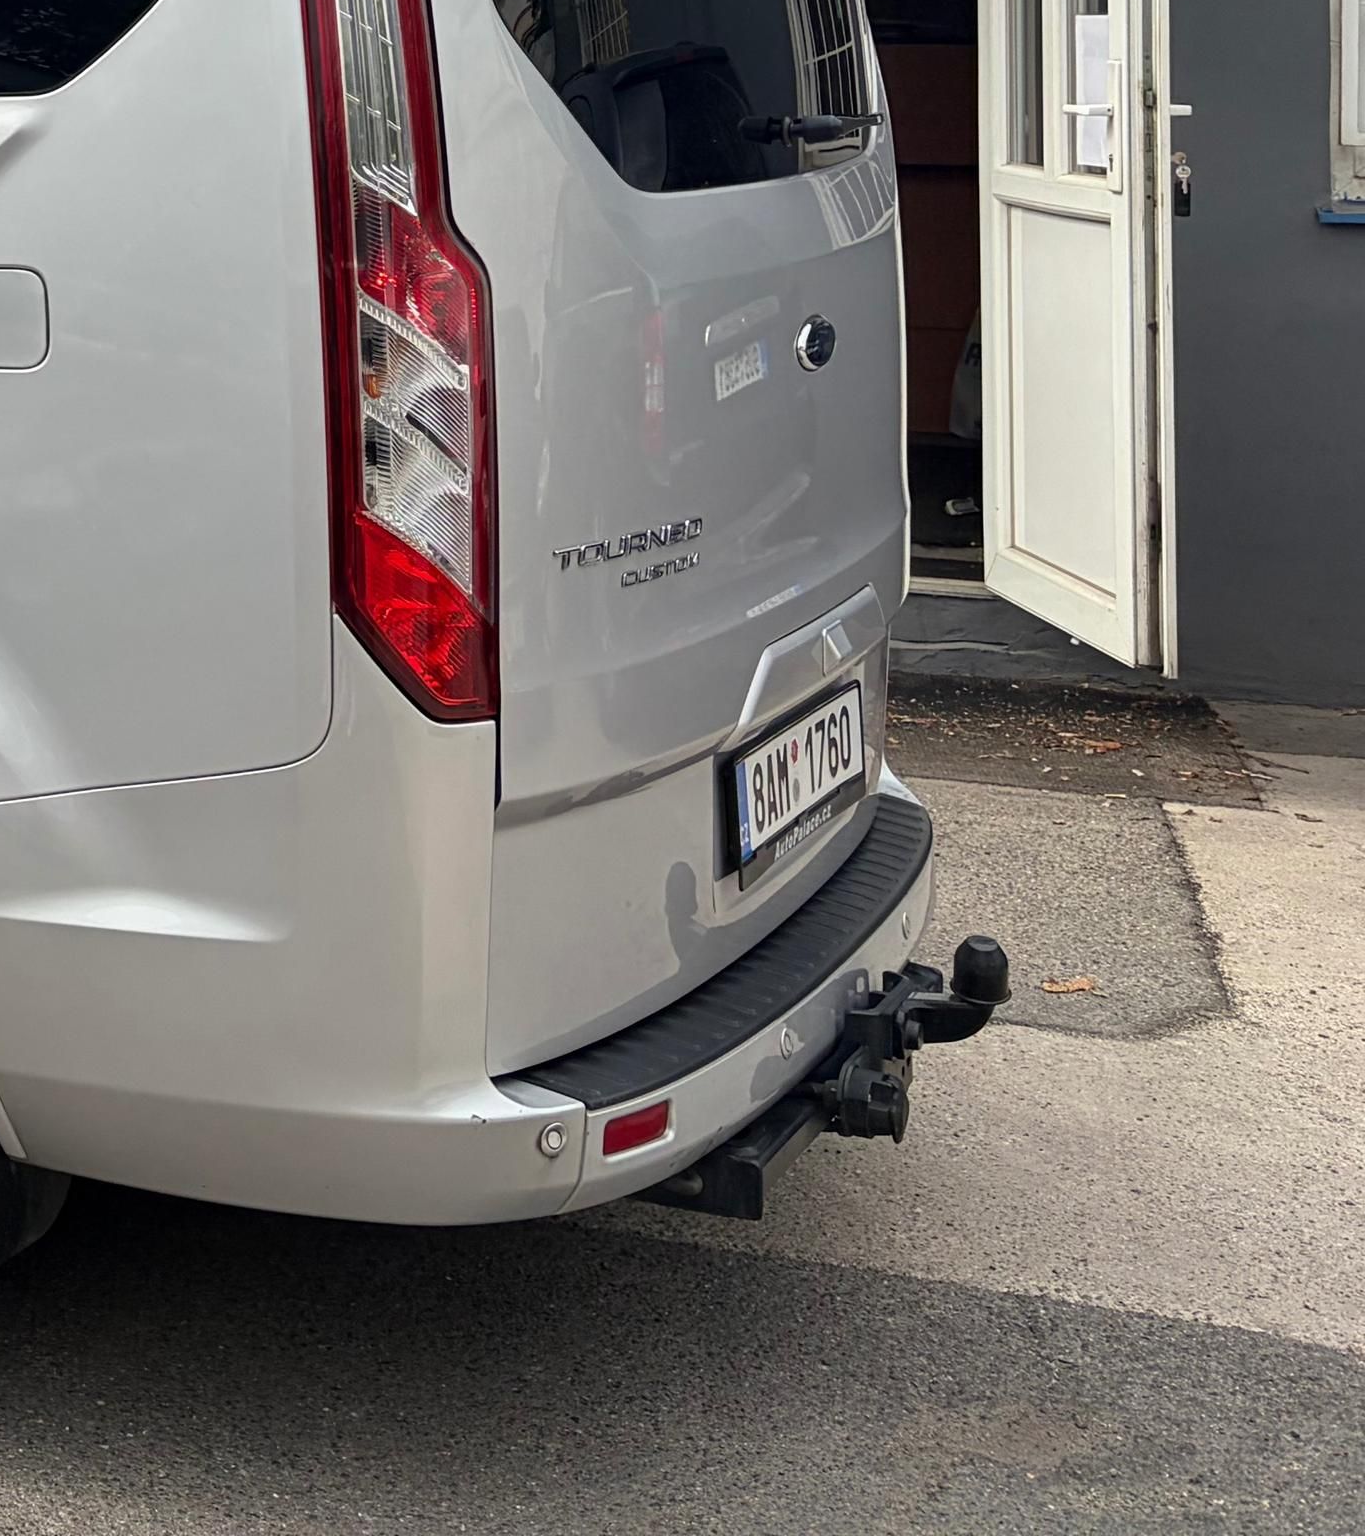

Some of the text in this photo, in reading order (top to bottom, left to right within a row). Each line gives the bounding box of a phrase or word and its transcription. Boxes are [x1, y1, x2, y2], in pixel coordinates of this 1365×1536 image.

[552, 517, 703, 571] TOURNEO
[752, 704, 852, 835] 8AM 1760
